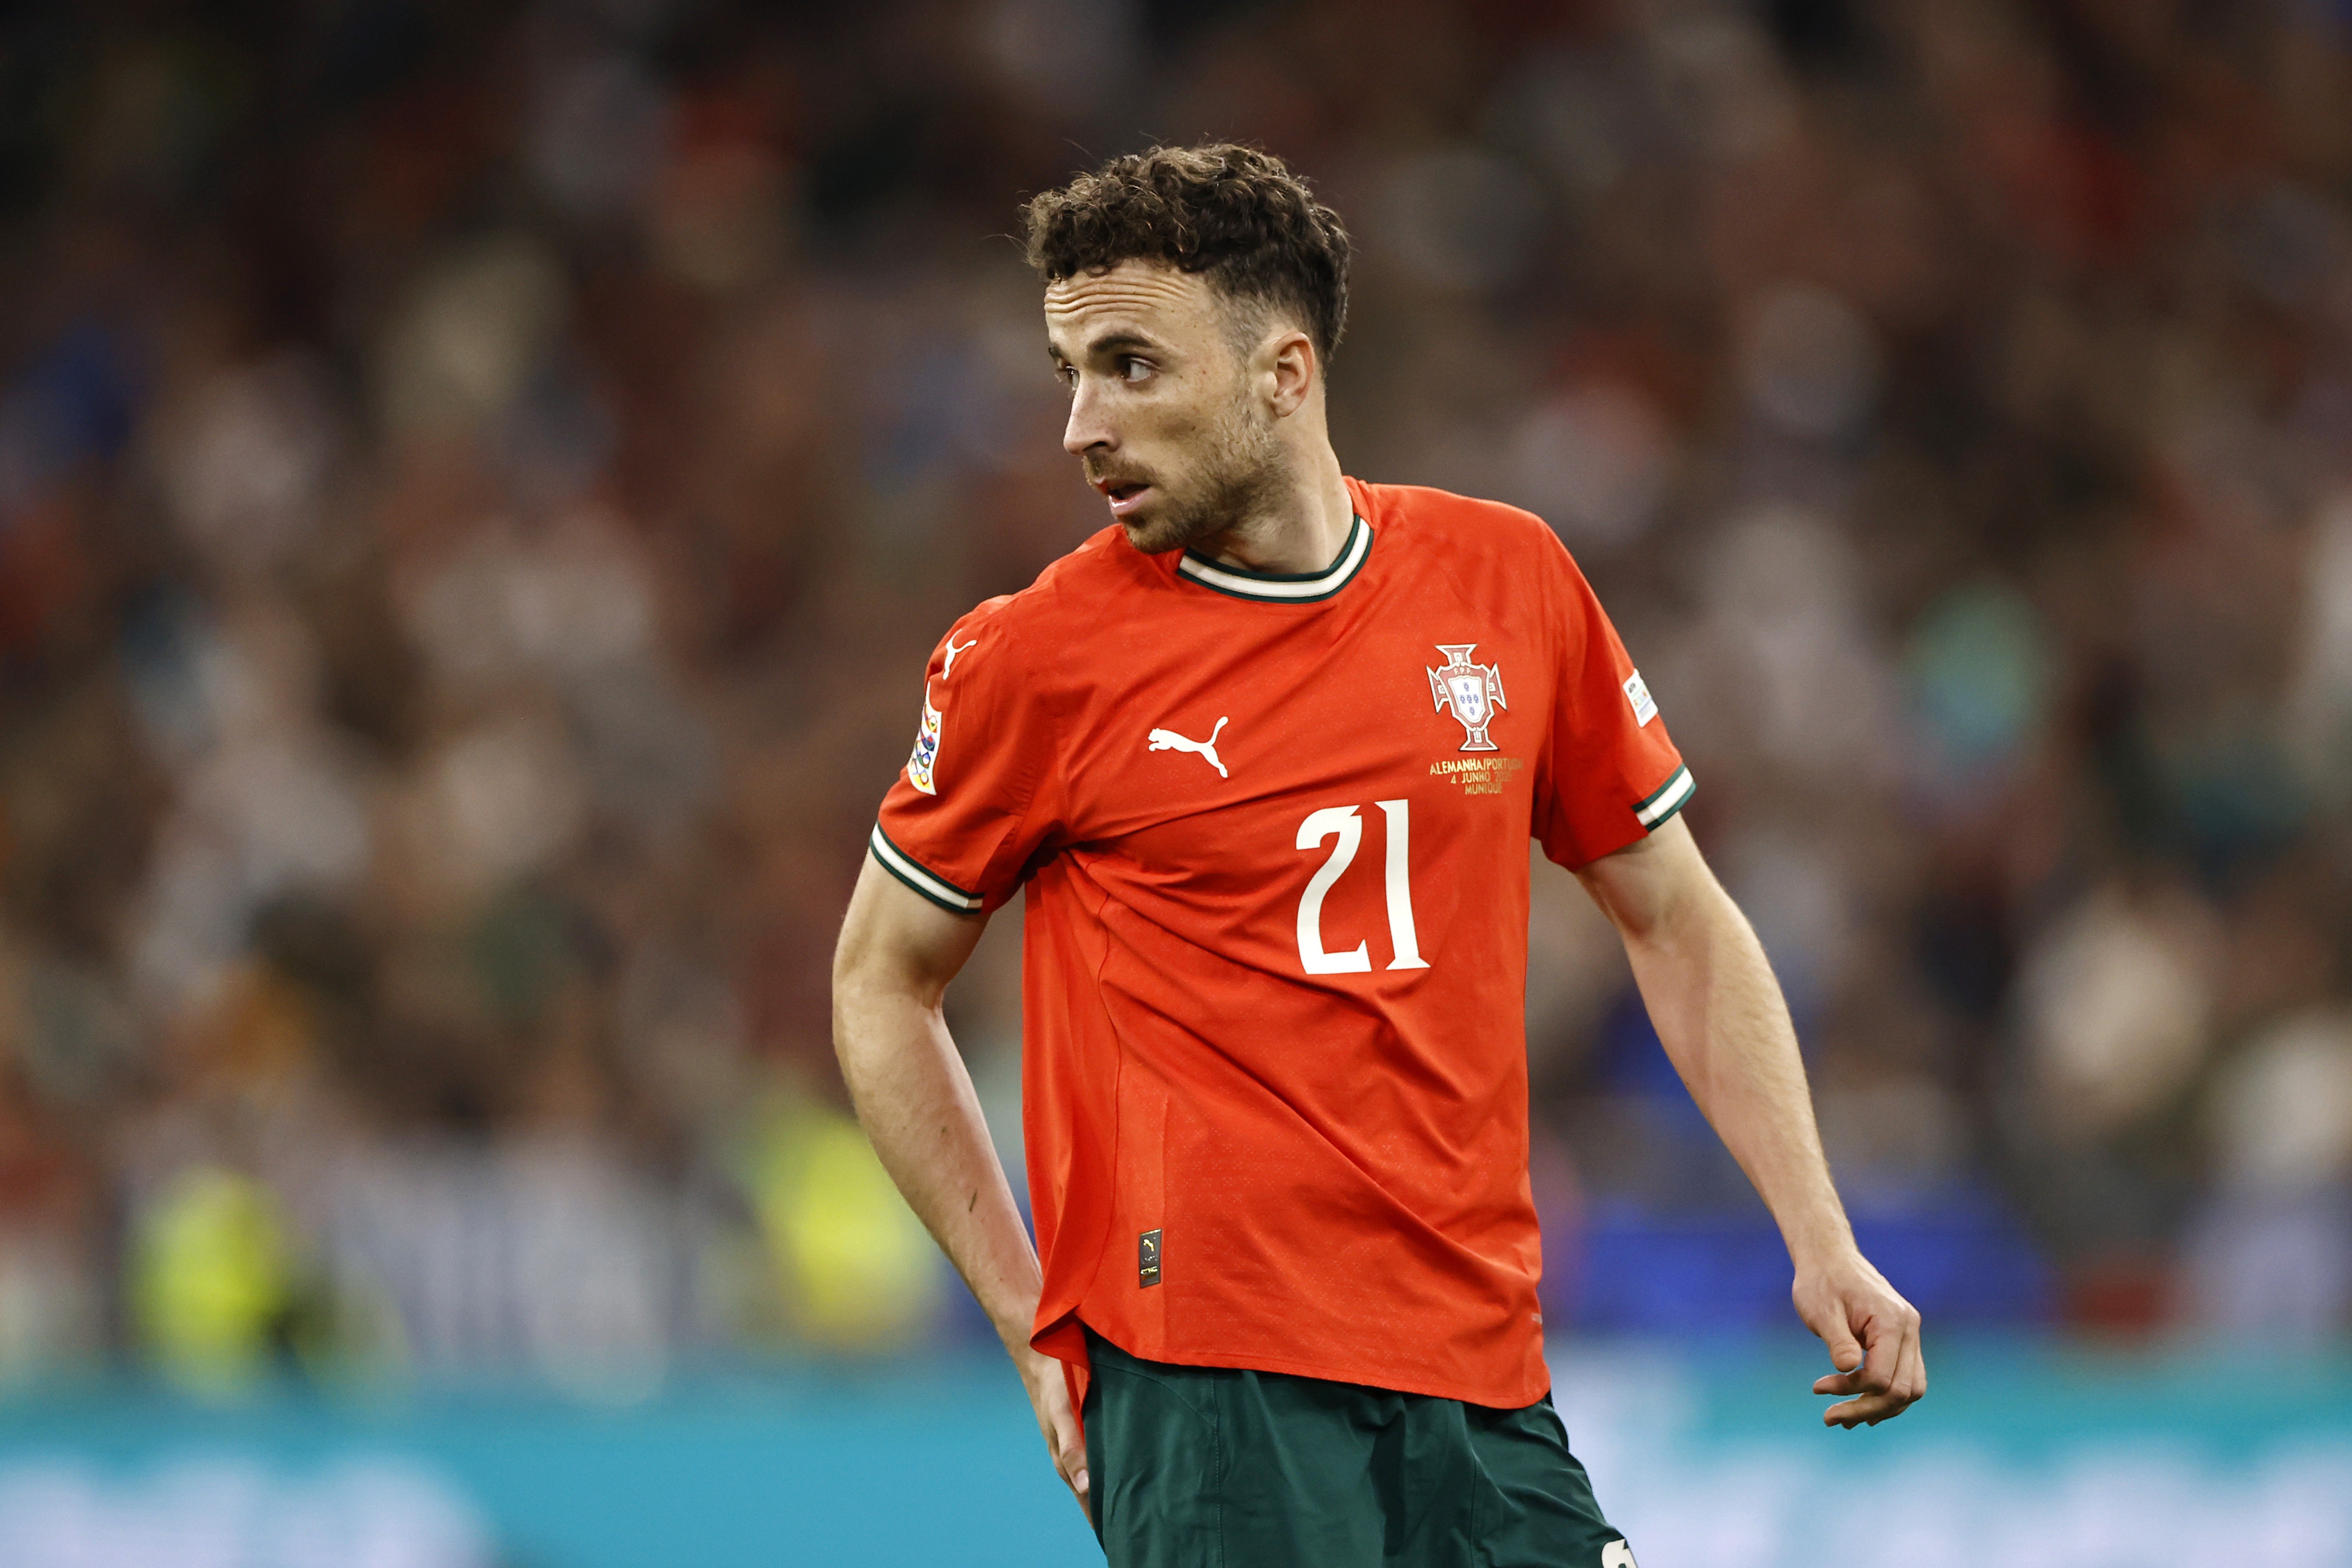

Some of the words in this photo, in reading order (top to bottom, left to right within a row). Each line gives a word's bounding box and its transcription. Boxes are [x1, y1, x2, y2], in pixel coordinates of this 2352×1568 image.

[1450, 774, 1457, 784] 4
[1461, 771, 1491, 784] JUNHO
[1296, 799, 1431, 974] 21
